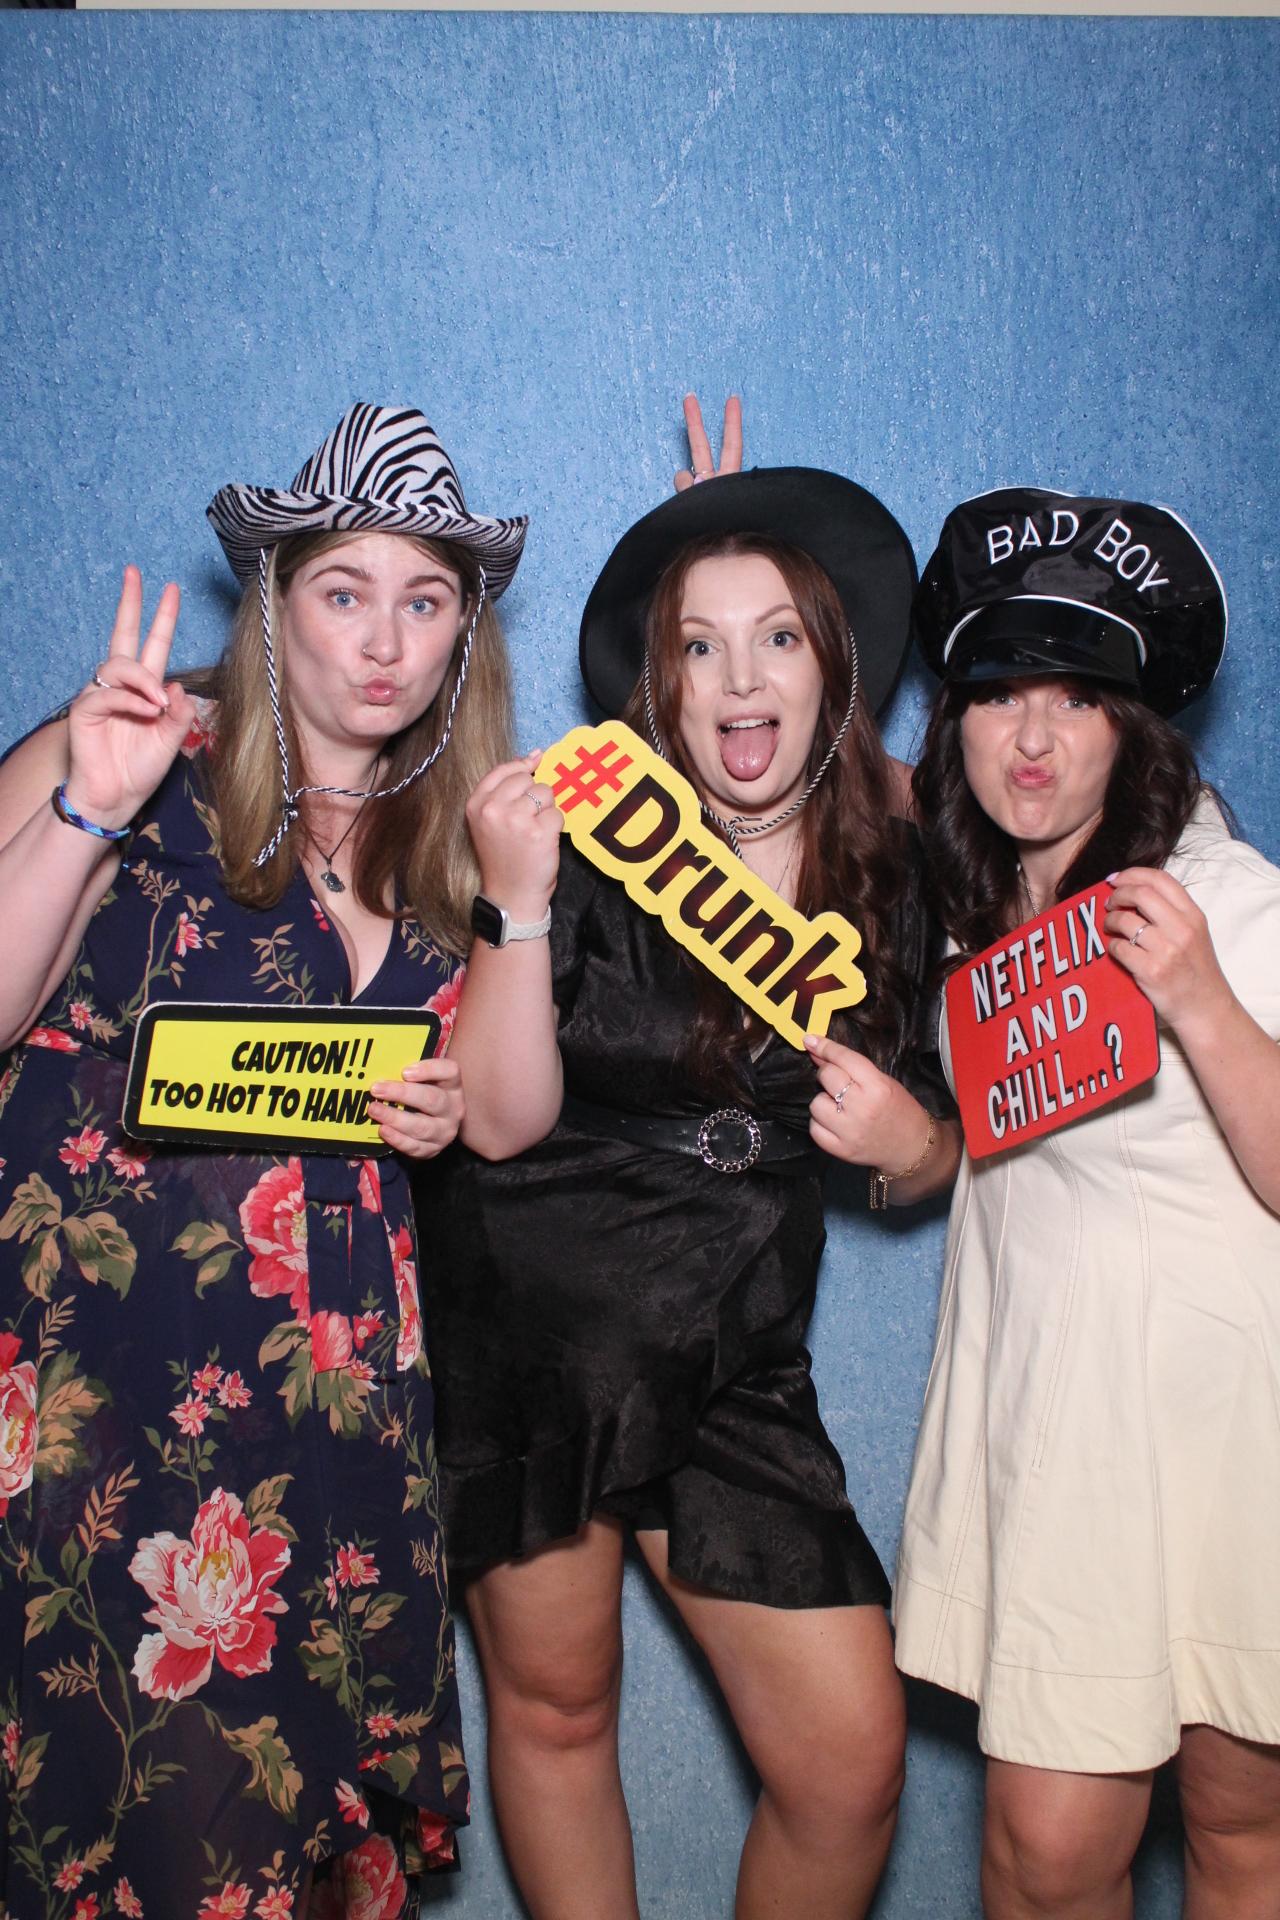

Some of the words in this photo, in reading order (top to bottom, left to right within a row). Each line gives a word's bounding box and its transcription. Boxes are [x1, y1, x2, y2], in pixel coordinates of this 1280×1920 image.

[987, 510, 1080, 565] BAD
[1093, 518, 1169, 593] BOY
[552, 740, 848, 1033] #Drunk
[970, 895, 1106, 1024] NETFLIX
[231, 1038, 374, 1080] CAUTION!!
[1006, 984, 1088, 1066] AND
[150, 1079, 204, 1109] TOO
[206, 1082, 265, 1114] HOT
[267, 1085, 301, 1119] TO
[301, 1087, 396, 1126] HAND
[987, 1023, 1125, 1140] CHILL...?
